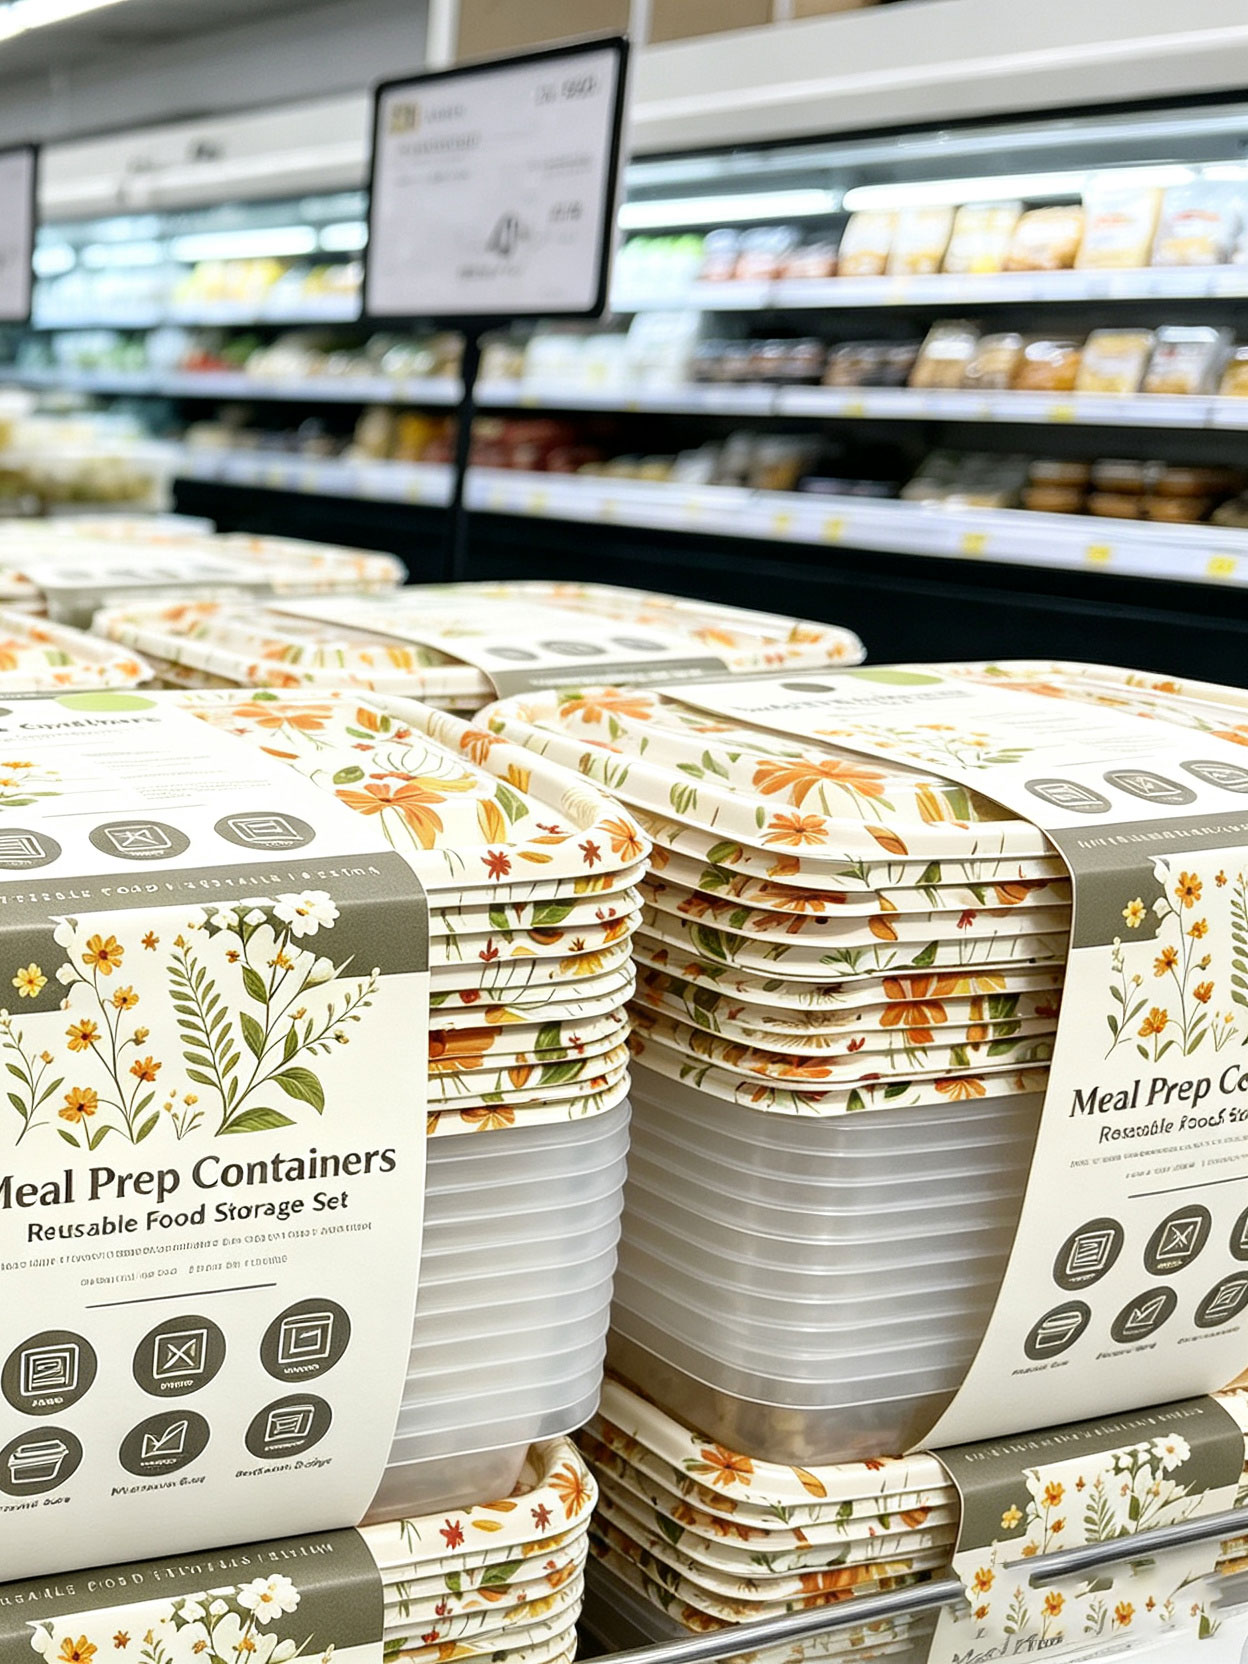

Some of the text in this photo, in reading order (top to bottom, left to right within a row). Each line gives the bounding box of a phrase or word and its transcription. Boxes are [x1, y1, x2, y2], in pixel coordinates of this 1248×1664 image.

[1068, 1079, 1141, 1118] Meal
[1145, 1077, 1212, 1109] Prep
[88, 1166, 181, 1204] Prep
[191, 1147, 397, 1189] Containers
[27, 1190, 349, 1243] Reusable Food Storage Set
